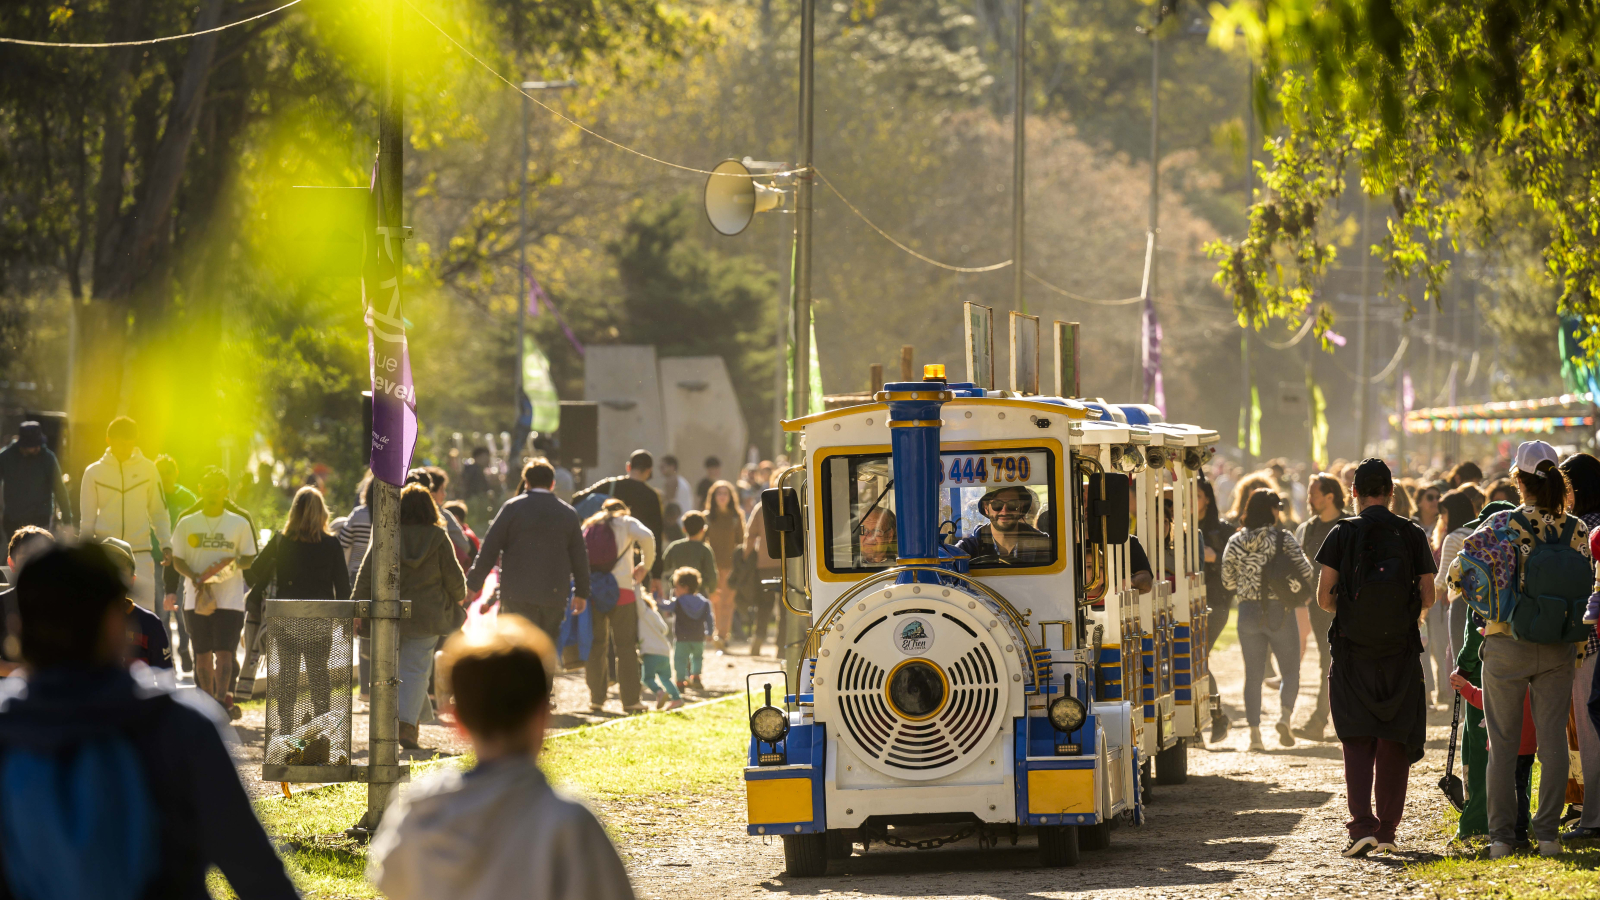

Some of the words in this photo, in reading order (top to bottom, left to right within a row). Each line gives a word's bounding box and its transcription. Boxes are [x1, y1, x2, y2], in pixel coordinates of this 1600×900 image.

[375, 351, 397, 372] ue
[374, 375, 417, 405] evel
[379, 435, 390, 445] de
[949, 457, 988, 484] 444
[991, 455, 1031, 482] 790
[902, 639, 911, 649] El
[911, 639, 926, 647] Tren
